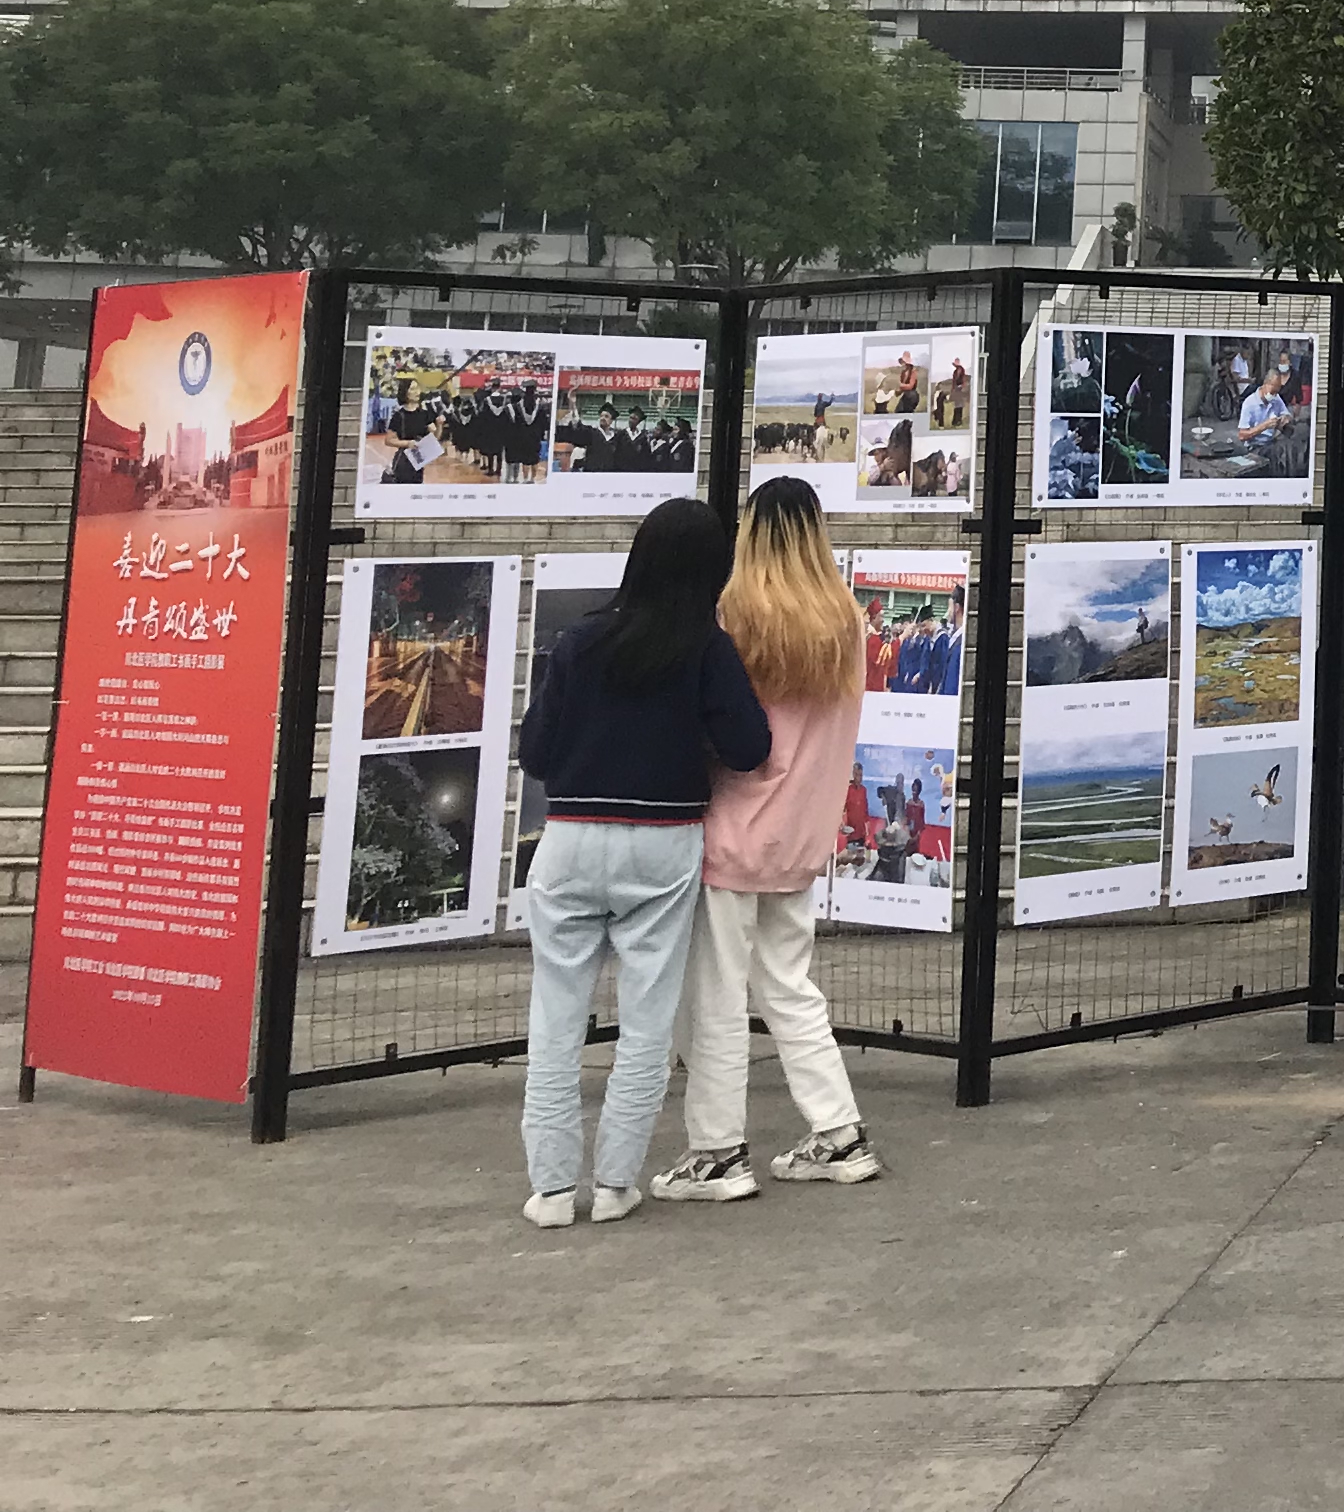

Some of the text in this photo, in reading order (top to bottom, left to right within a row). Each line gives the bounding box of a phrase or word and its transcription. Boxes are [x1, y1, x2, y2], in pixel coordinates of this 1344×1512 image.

[112, 531, 250, 580] 喜迎二十大
